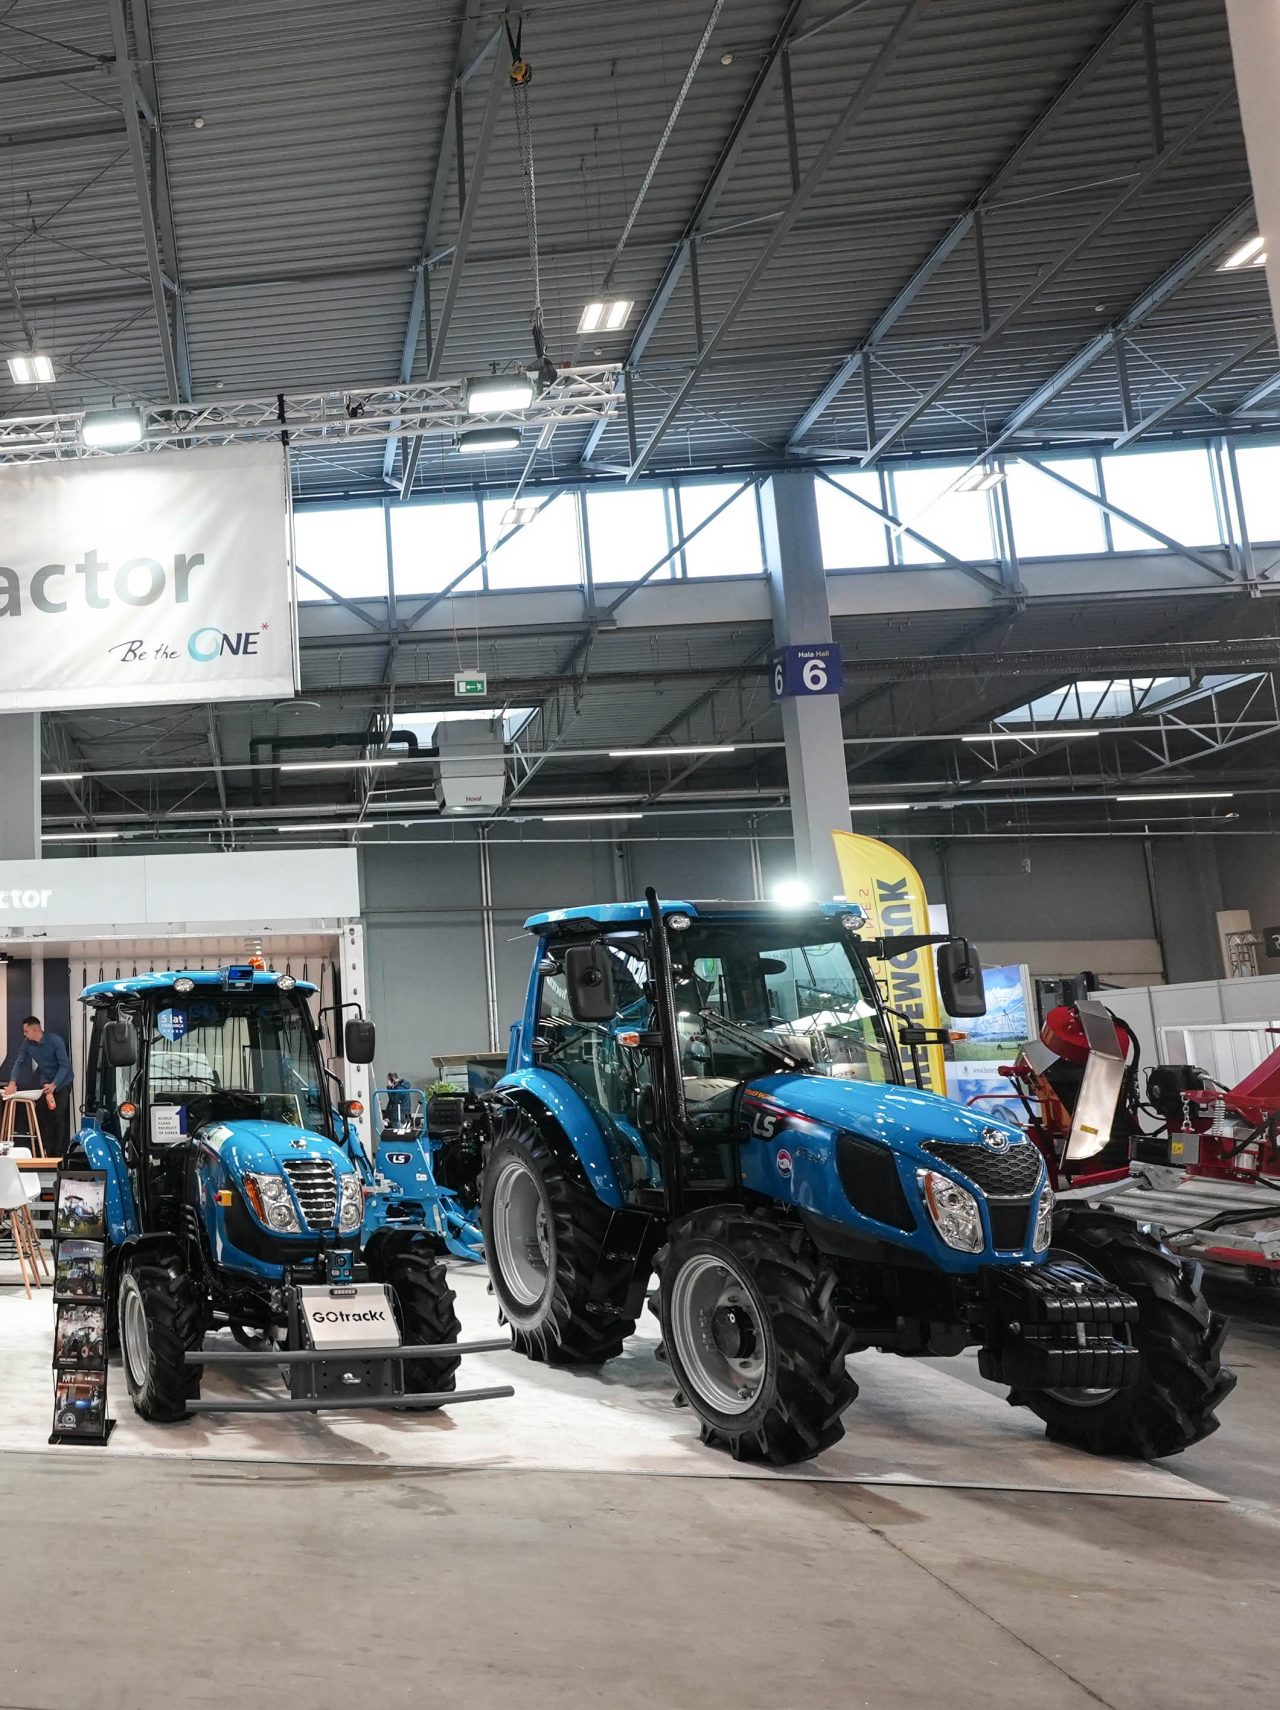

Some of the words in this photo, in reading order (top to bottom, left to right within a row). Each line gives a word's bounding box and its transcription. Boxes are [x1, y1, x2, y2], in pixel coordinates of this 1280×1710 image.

[110, 640, 147, 662] Be
[154, 643, 180, 659] the
[774, 664, 784, 696] 6
[803, 659, 828, 691] 6
[170, 1013, 183, 1023] lat
[752, 1112, 777, 1138] LS
[392, 1155, 405, 1164] LS
